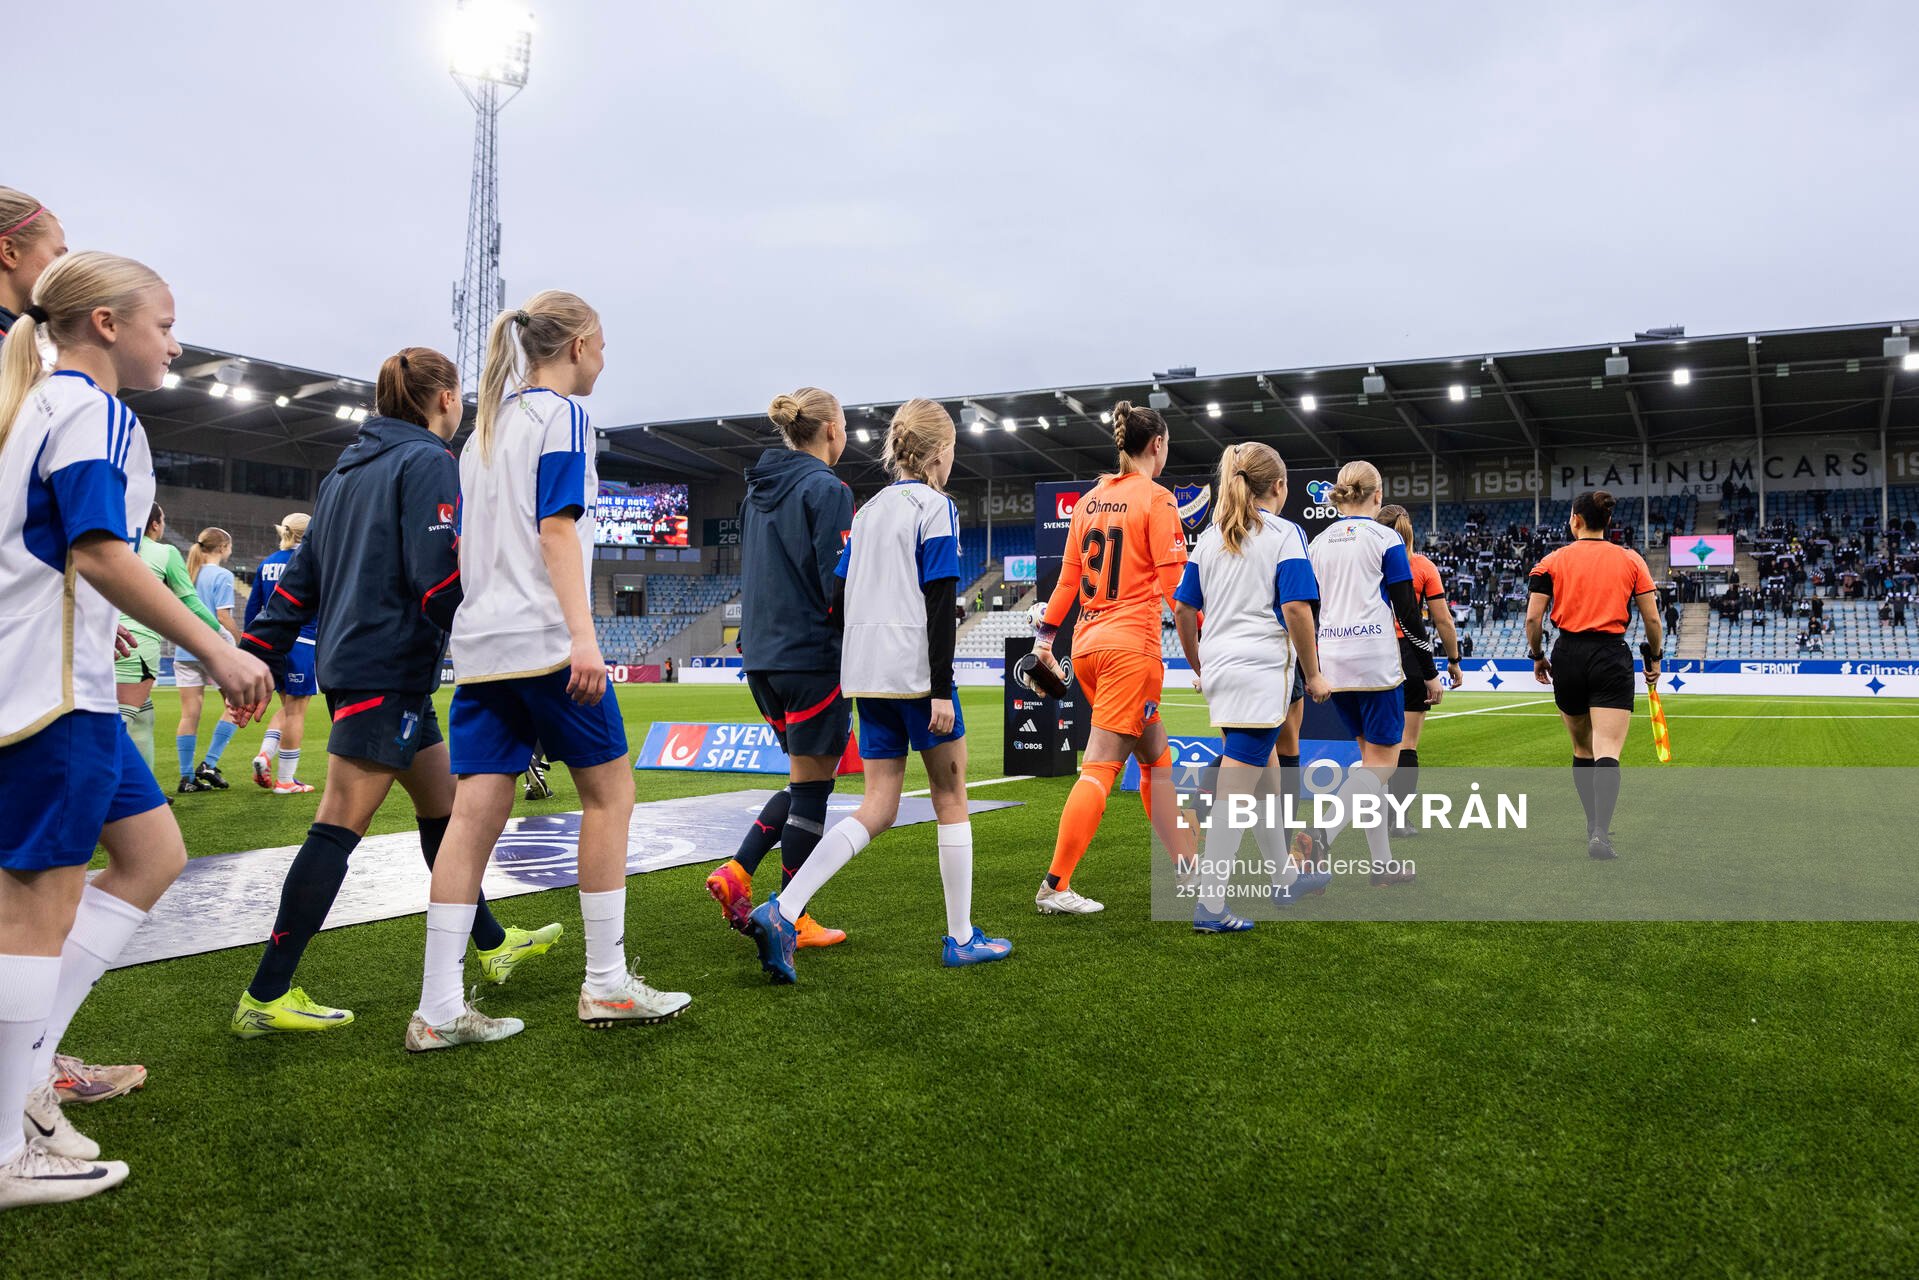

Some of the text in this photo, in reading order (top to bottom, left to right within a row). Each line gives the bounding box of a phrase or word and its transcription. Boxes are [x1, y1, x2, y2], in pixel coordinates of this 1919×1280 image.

[1383, 473, 1449, 498] 1952
[1471, 469, 1544, 494] 1956
[980, 494, 1034, 515] 1943
[1086, 497, 1128, 514] Öhman
[1080, 526, 1124, 601] 31
[1761, 663, 1800, 674] FRONT
[712, 725, 780, 746] SVEN
[703, 748, 761, 769] SPEL
